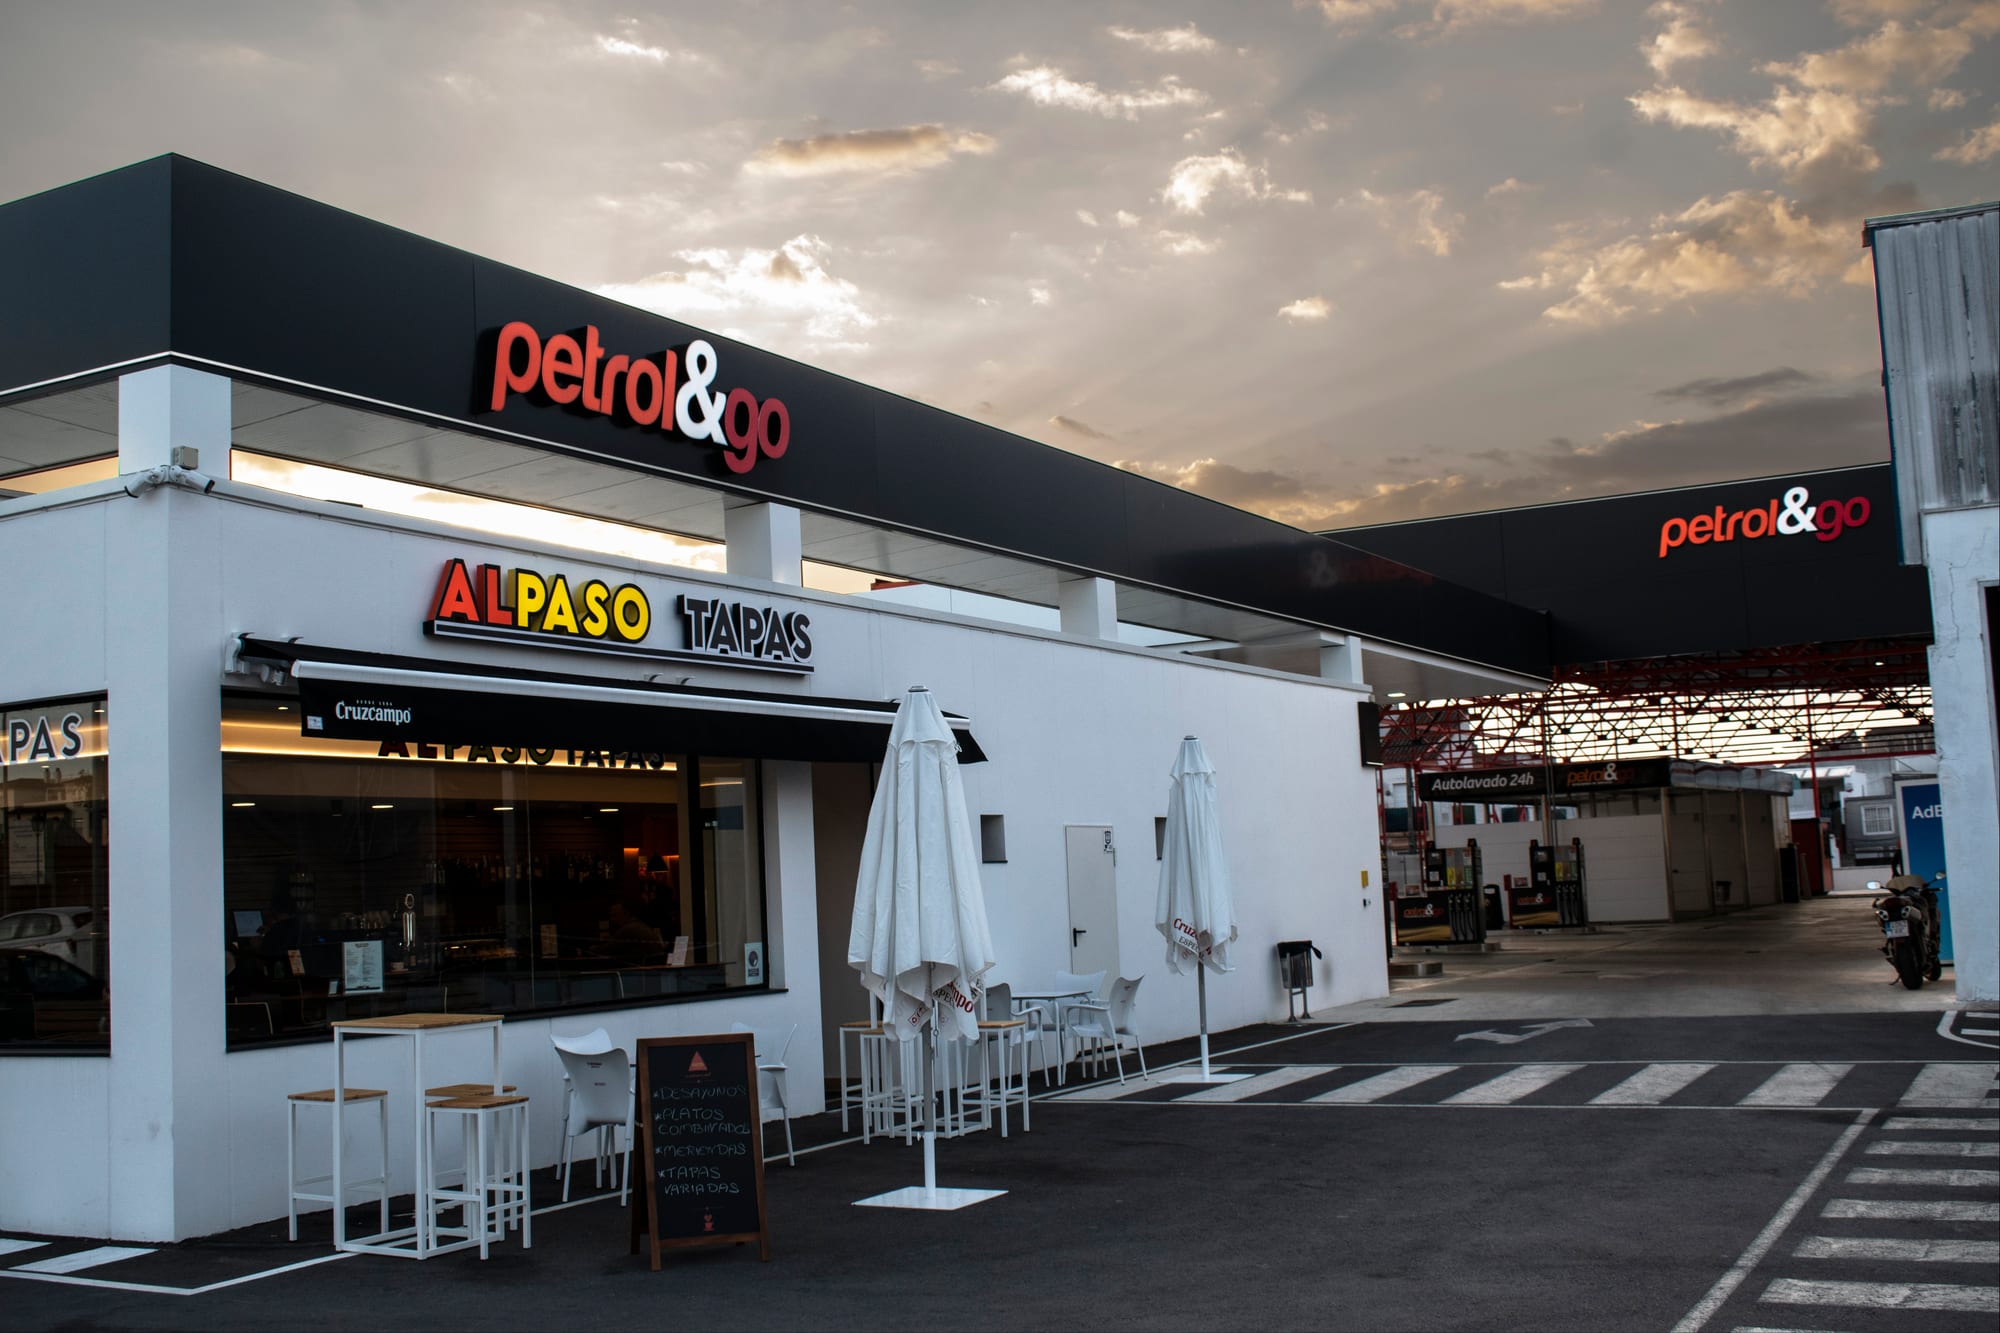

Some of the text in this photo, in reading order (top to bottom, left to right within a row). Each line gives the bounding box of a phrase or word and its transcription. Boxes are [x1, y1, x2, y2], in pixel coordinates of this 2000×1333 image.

[490, 320, 791, 475] petrol&go
[1658, 486, 1871, 559] petrol&go
[678, 594, 813, 664] TAPAS
[335, 699, 412, 726] Cruzcampo
[0, 712, 83, 766] PAS
[1431, 771, 1534, 792] Autolavado 24h
[1173, 917, 1201, 941] Cruz
[661, 1107, 726, 1122] PLATOS
[662, 1142, 748, 1158] MERIENDAS
[666, 1165, 722, 1180] TAPAS
[663, 1182, 741, 1196] VARIADAS
